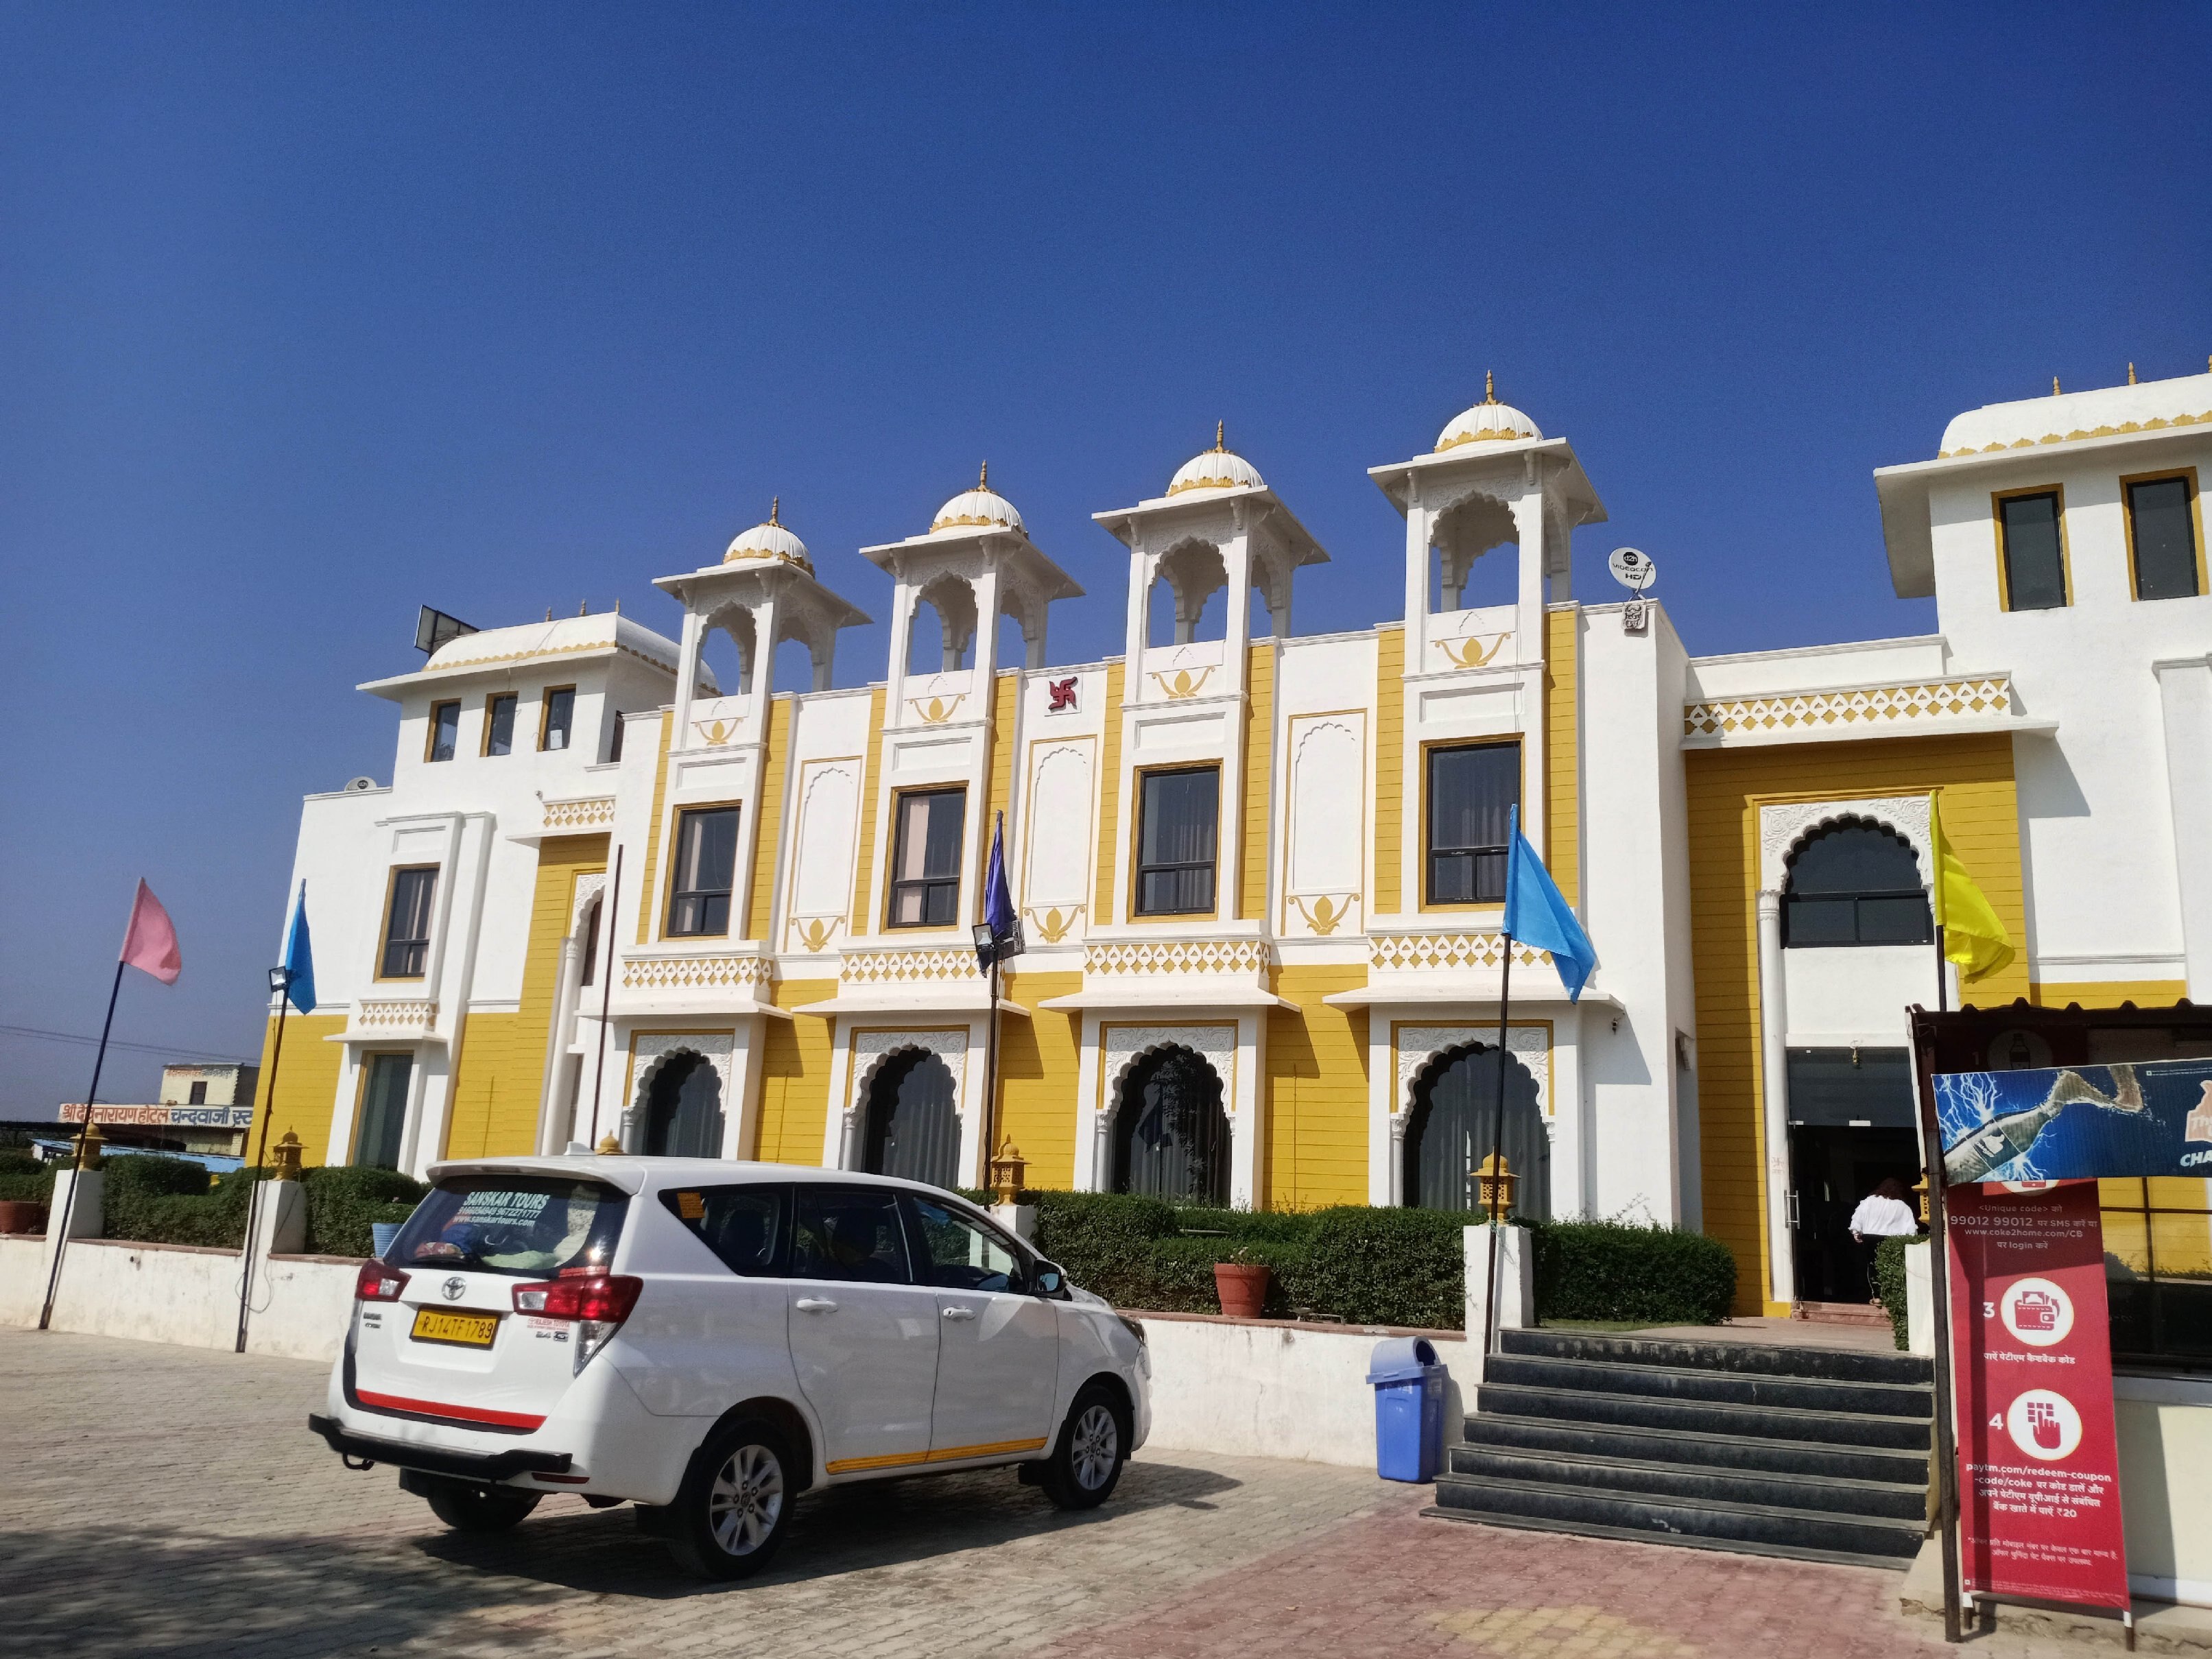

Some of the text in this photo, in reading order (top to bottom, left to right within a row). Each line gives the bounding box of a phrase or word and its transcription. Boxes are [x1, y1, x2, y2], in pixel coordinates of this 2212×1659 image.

[62, 1104, 77, 1121] श्री
[77, 1104, 138, 1123] देवनारायण
[138, 1105, 170, 1123] होटल
[171, 1107, 230, 1125] चन्दवाजी
[463, 1191, 551, 1210] SANSKAR TOURS
[453, 1215, 536, 1227] www.sanskartours.com
[1951, 1216, 1989, 1226] 99012
[1993, 1217, 2033, 1226] 99012
[1964, 1228, 2084, 1238] www.coke2home.com/CB
[2009, 1241, 2033, 1249] login
[1983, 1302, 1995, 1318] 3
[422, 1316, 494, 1339] RJ14TF1789
[1999, 1351, 2025, 1362] पेटीएम
[2057, 1354, 2076, 1364] कोड
[1989, 1413, 2003, 1430] 4
[1966, 1464, 2112, 1482] paytm.com/redeem-coupon
[1975, 1477, 2104, 1494] -code/coke पर कोड डालें और
[1979, 1488, 1999, 1499] अपने
[2000, 1489, 2025, 1501] पेटीएम
[2062, 1495, 2069, 1504] से
[2010, 1502, 2027, 1513] खाते
[2029, 1501, 2037, 1514] में
[2057, 1507, 2077, 1518] ₹20
